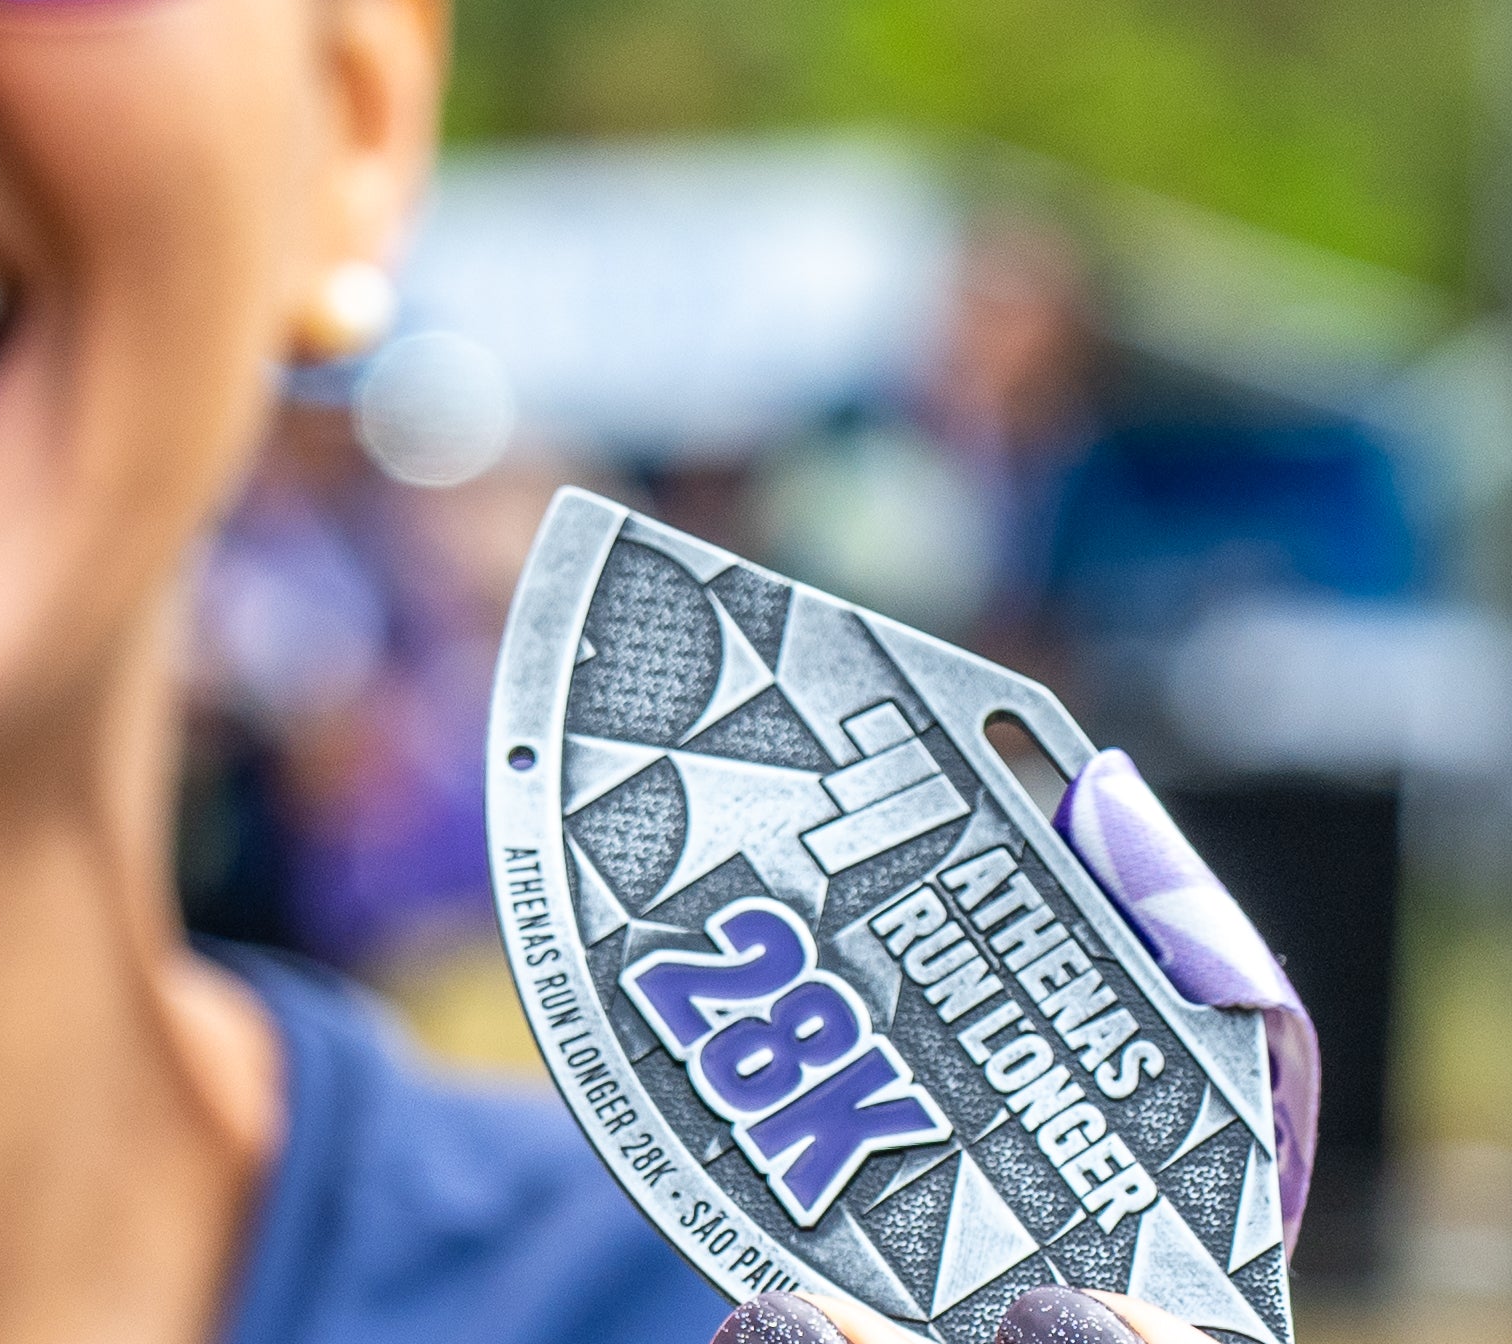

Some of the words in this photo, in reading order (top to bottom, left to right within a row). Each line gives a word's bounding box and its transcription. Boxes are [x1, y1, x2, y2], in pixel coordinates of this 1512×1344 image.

[504, 847, 560, 967] ATHENAS
[534, 973, 584, 1030] RUN
[559, 1031, 639, 1137] LONGER
[620, 1133, 678, 1187] 28K
[728, 1246, 800, 1293] PAU
[620, 896, 954, 1228] 28K
[869, 886, 1004, 1024] RUN
[957, 1000, 1158, 1234] LONGER
[937, 846, 1165, 1100] ATHENAS
